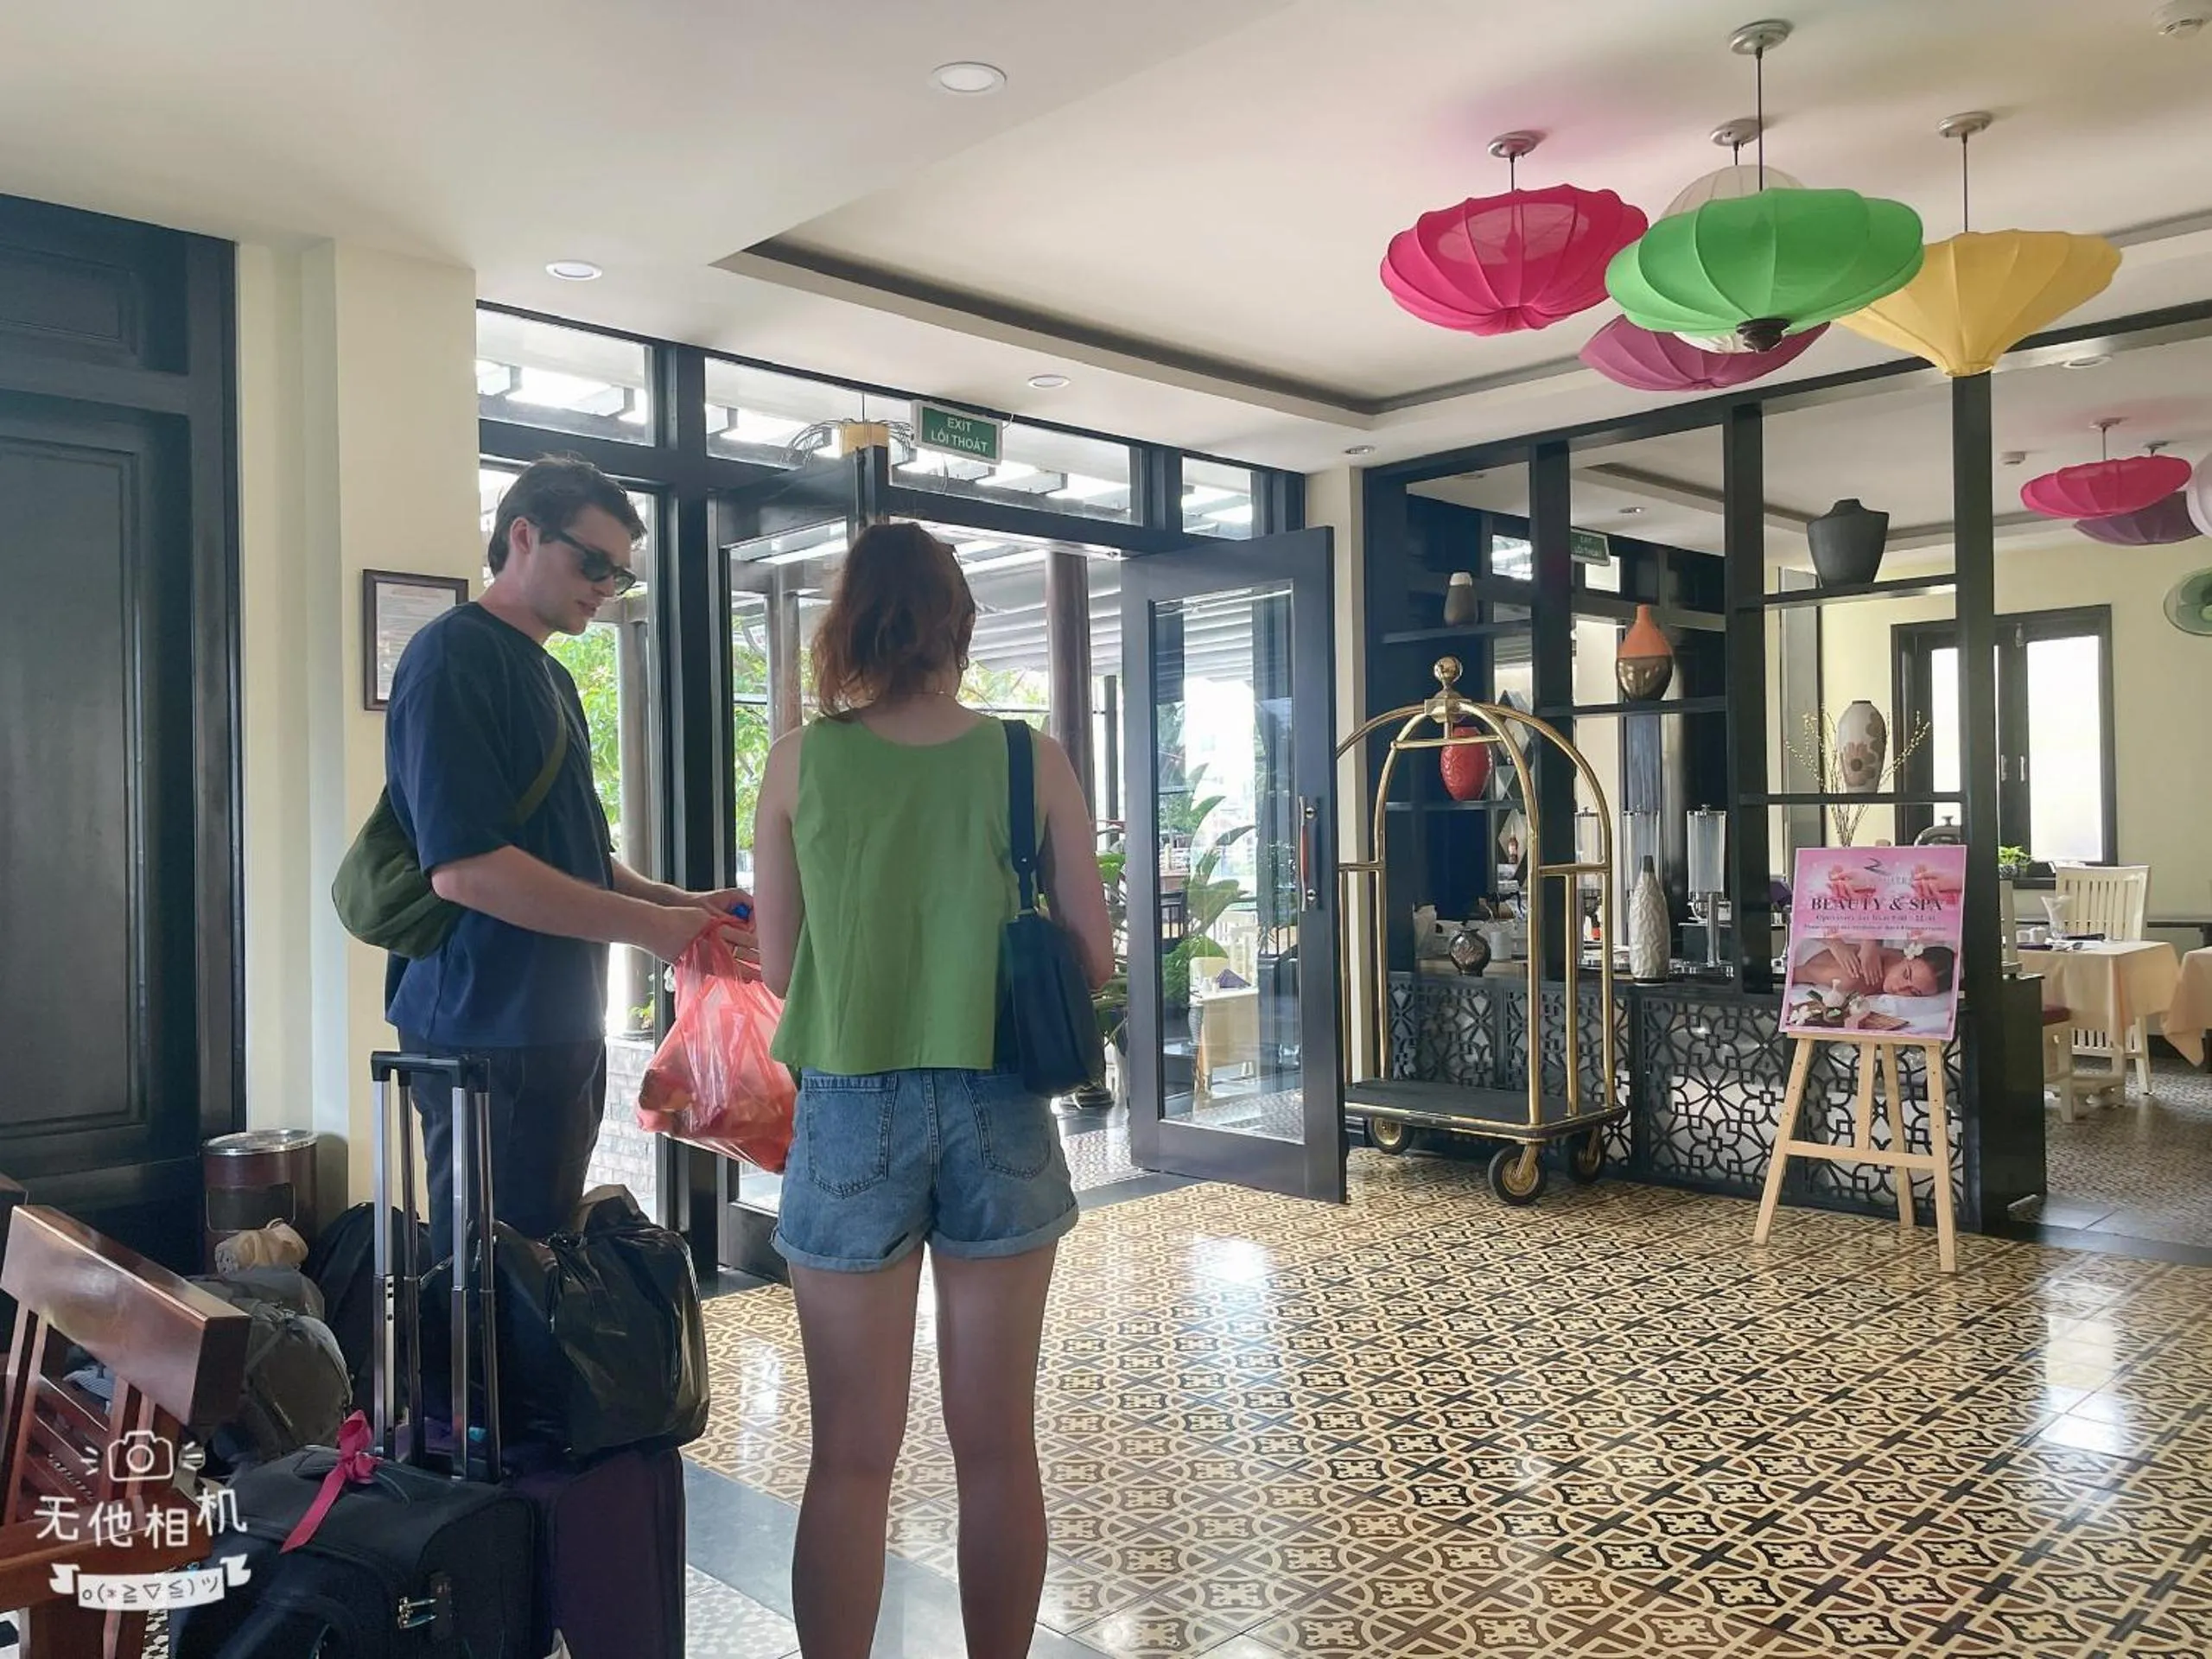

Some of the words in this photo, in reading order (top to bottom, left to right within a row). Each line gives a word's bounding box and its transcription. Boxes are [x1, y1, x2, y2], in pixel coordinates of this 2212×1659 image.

[947, 416, 972, 433] EXIT
[950, 433, 988, 453] THOÁT
[1811, 897, 1881, 912] BEAUTY
[1889, 897, 1904, 912] &
[1908, 897, 1943, 912] SPA
